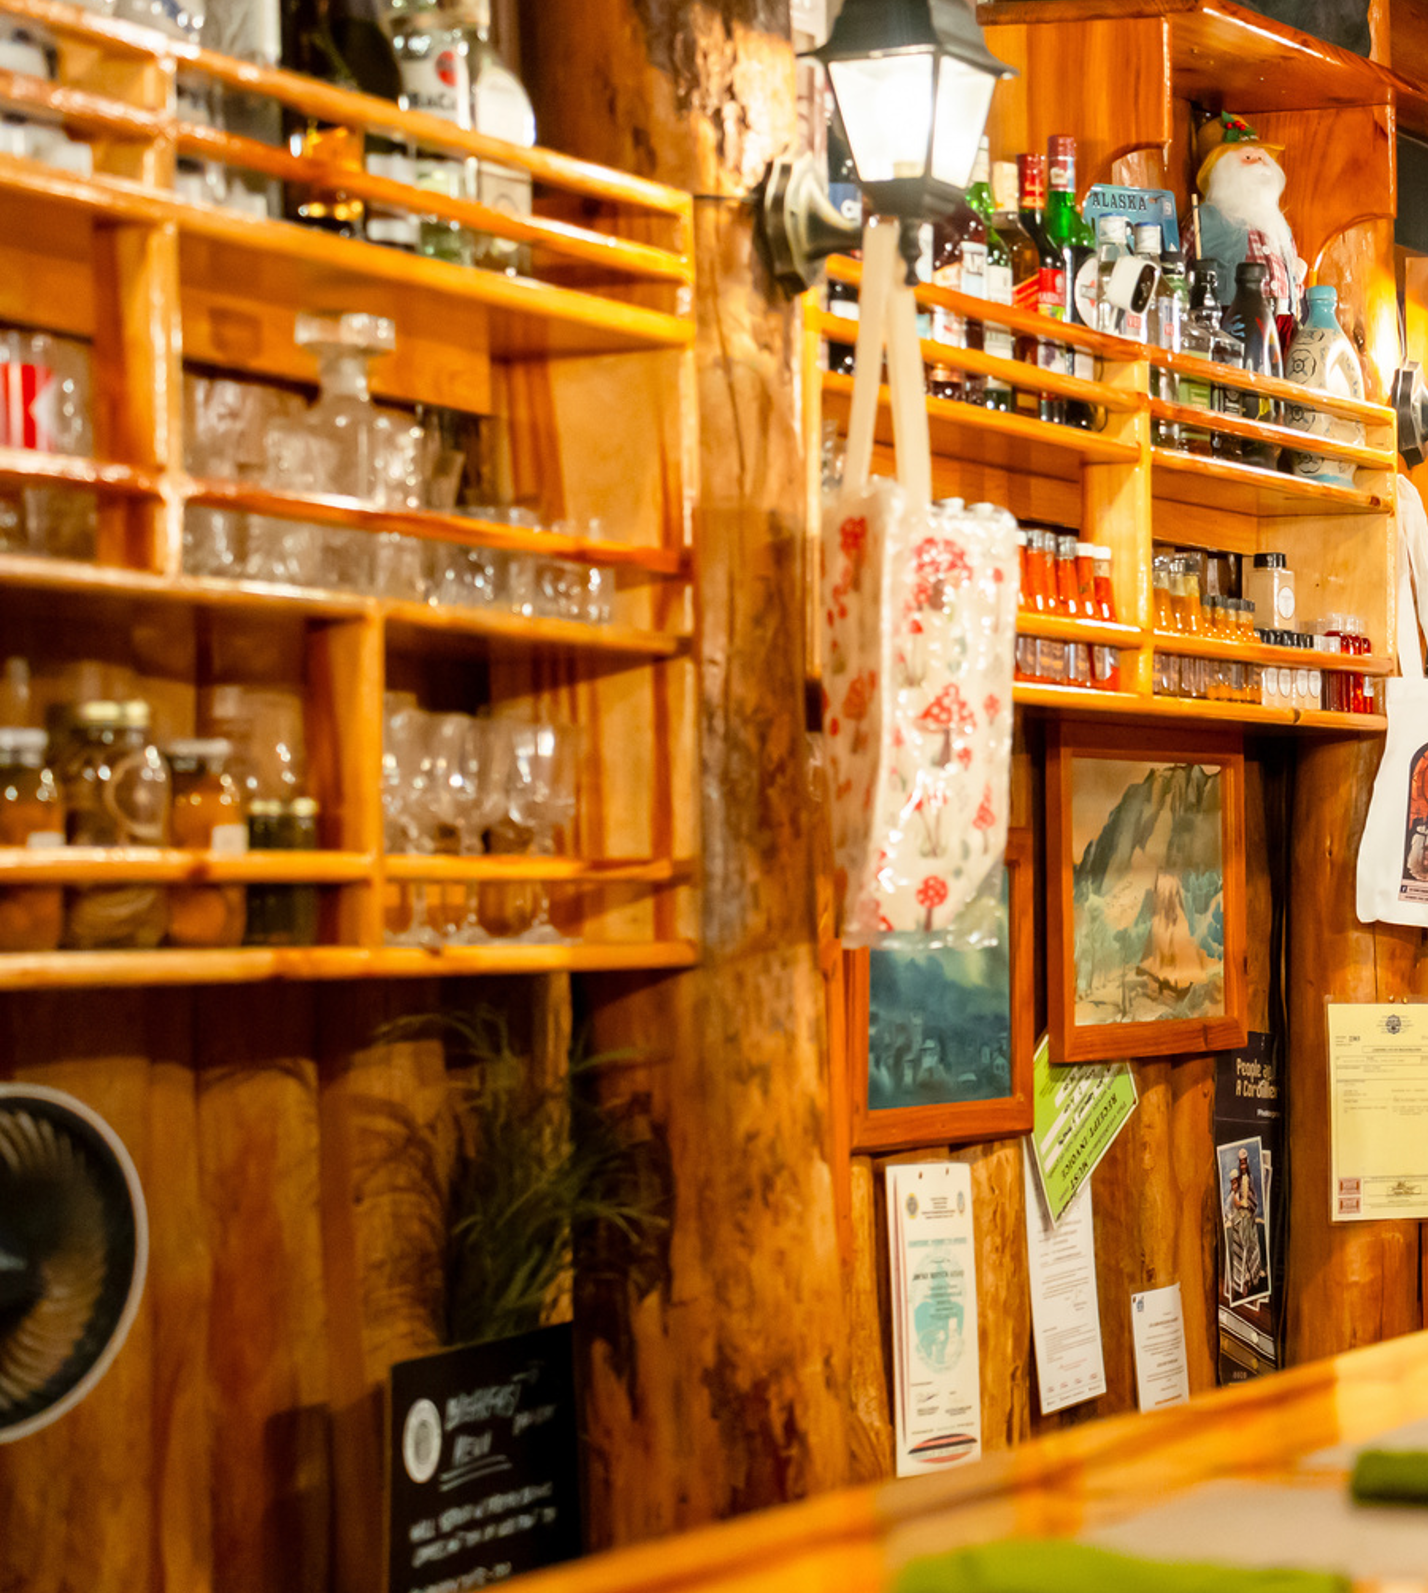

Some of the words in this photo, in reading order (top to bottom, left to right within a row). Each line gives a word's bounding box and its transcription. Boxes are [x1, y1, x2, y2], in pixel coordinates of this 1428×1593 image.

[1092, 192, 1147, 210] ALASKA
[1236, 1057, 1262, 1083] People
[1089, 1092, 1118, 1139] RECEIPT
[1069, 1161, 1090, 1191] MUST
